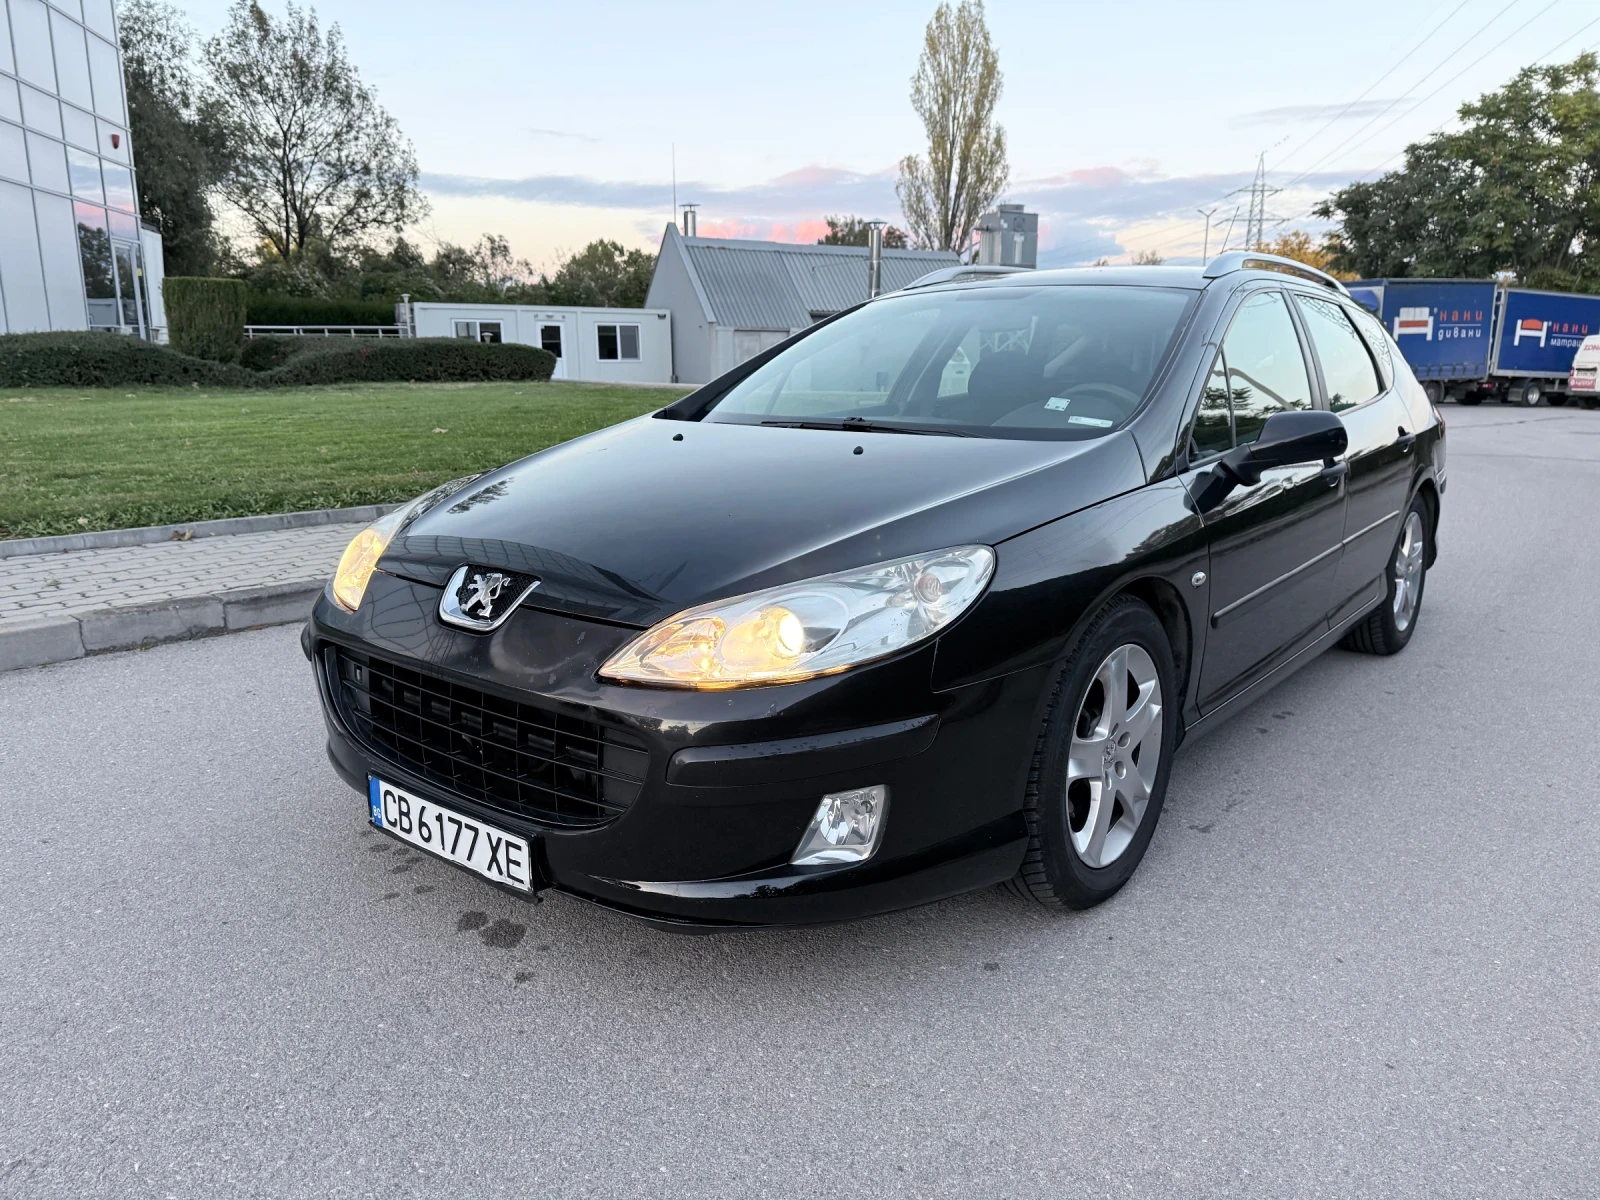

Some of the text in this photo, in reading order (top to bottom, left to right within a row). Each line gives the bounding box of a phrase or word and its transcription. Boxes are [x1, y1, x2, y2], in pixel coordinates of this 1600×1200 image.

[1439, 310, 1483, 322] нани
[1552, 321, 1588, 334] нани
[373, 804, 381, 819] BG
[383, 789, 524, 885] CB 6177 XE
